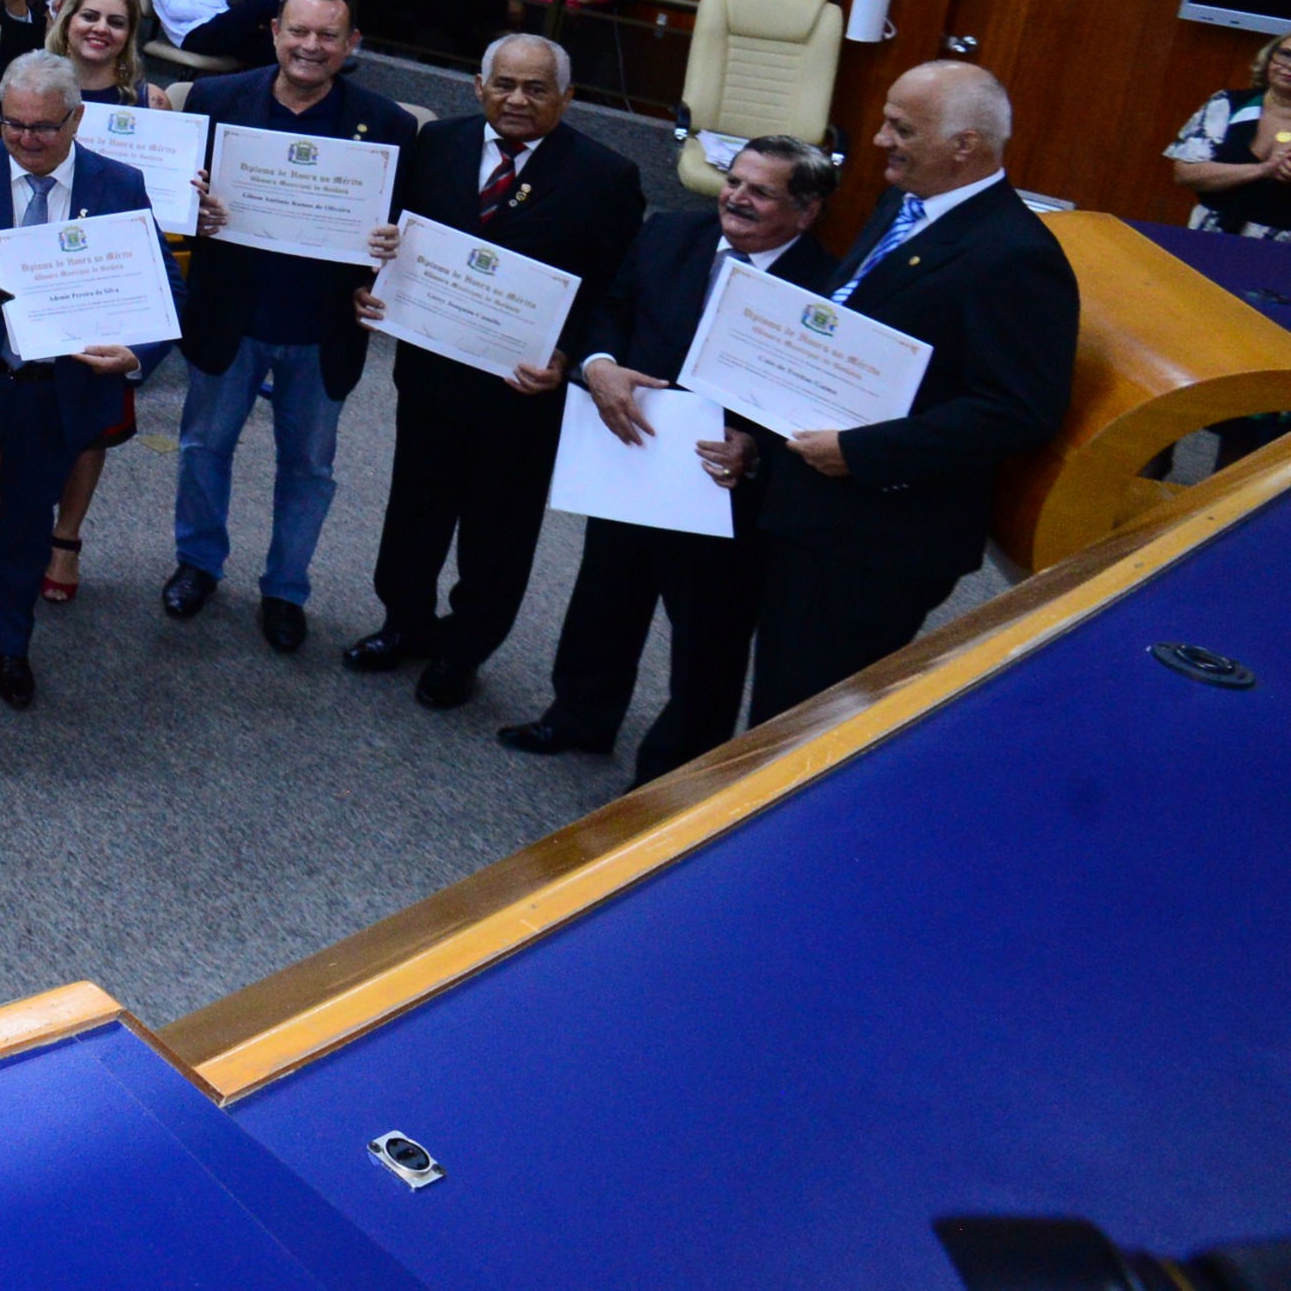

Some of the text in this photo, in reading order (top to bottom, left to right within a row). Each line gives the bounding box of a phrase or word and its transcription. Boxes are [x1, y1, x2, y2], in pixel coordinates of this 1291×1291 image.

[239, 162, 274, 176] Diploma
[290, 169, 317, 181] Honra
[332, 175, 363, 187] Mérito
[291, 200, 313, 208] Ramos
[324, 204, 351, 213] Oliveira
[20, 248, 133, 273] Diploma de Honra ao Mérito
[48, 293, 70, 302] Ademir
[71, 290, 94, 299] Pereira
[103, 286, 119, 294] Silva
